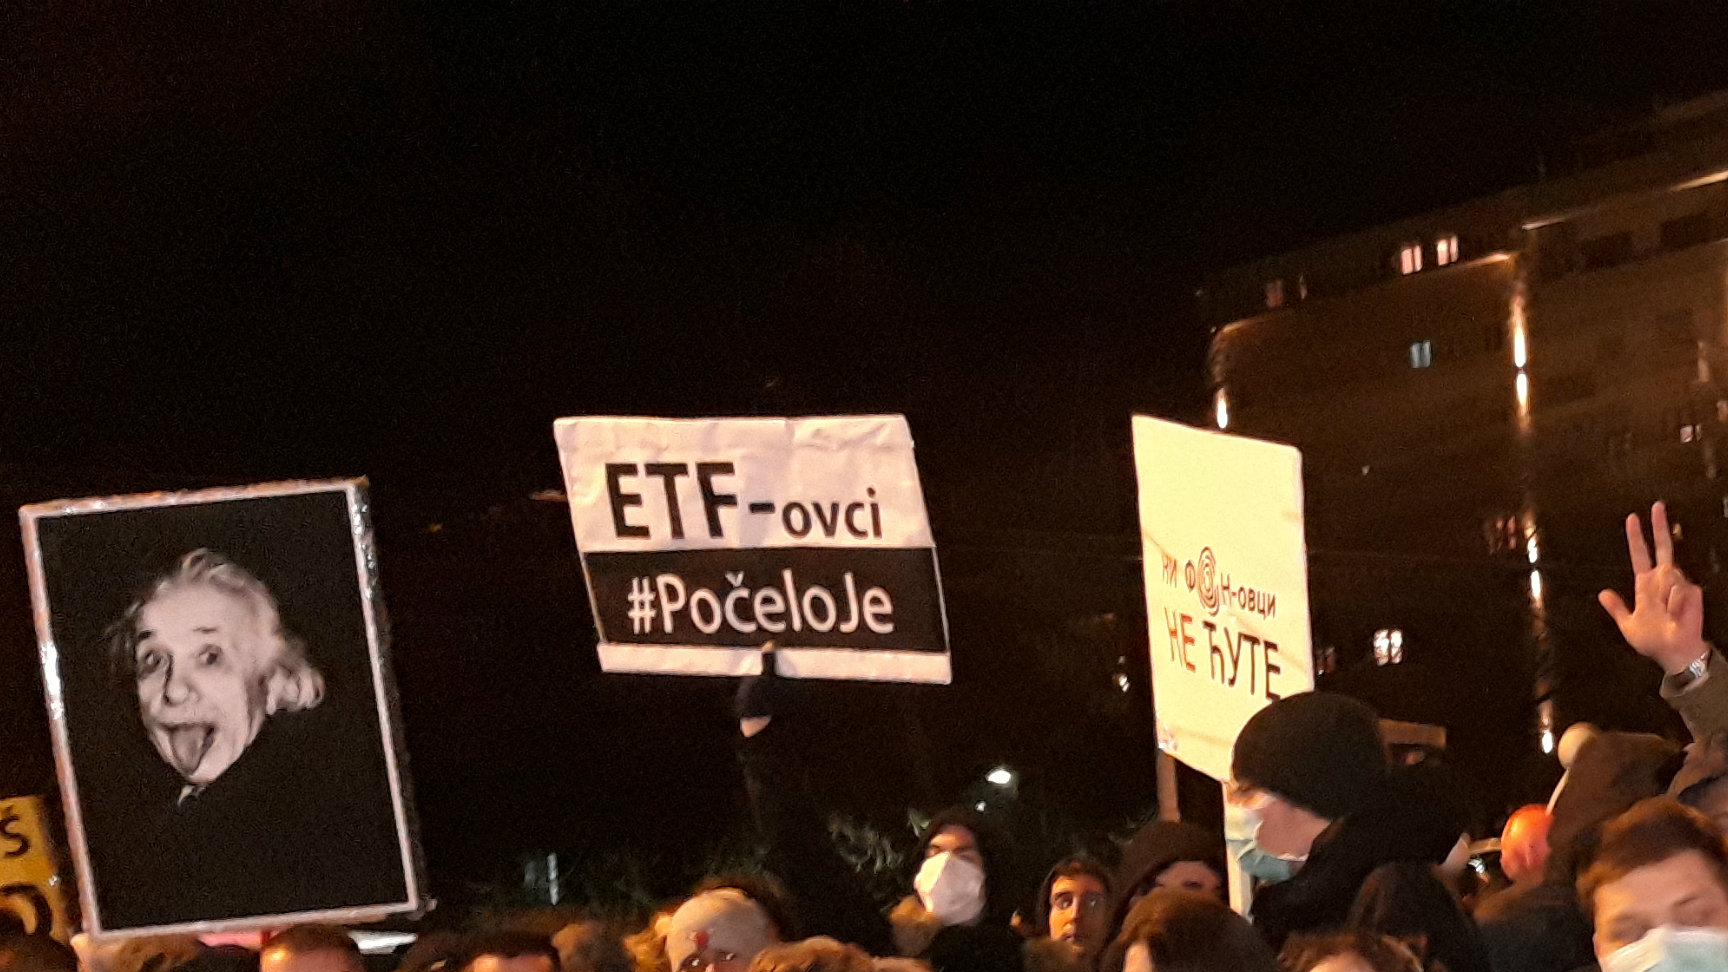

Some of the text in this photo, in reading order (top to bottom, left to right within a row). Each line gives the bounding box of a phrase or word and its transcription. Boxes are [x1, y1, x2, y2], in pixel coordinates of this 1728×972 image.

[604, 461, 883, 540] ETF-ovci
[627, 567, 895, 635] #PočeloJe
[1164, 606, 1282, 702] НЕ ЋУТЕ
